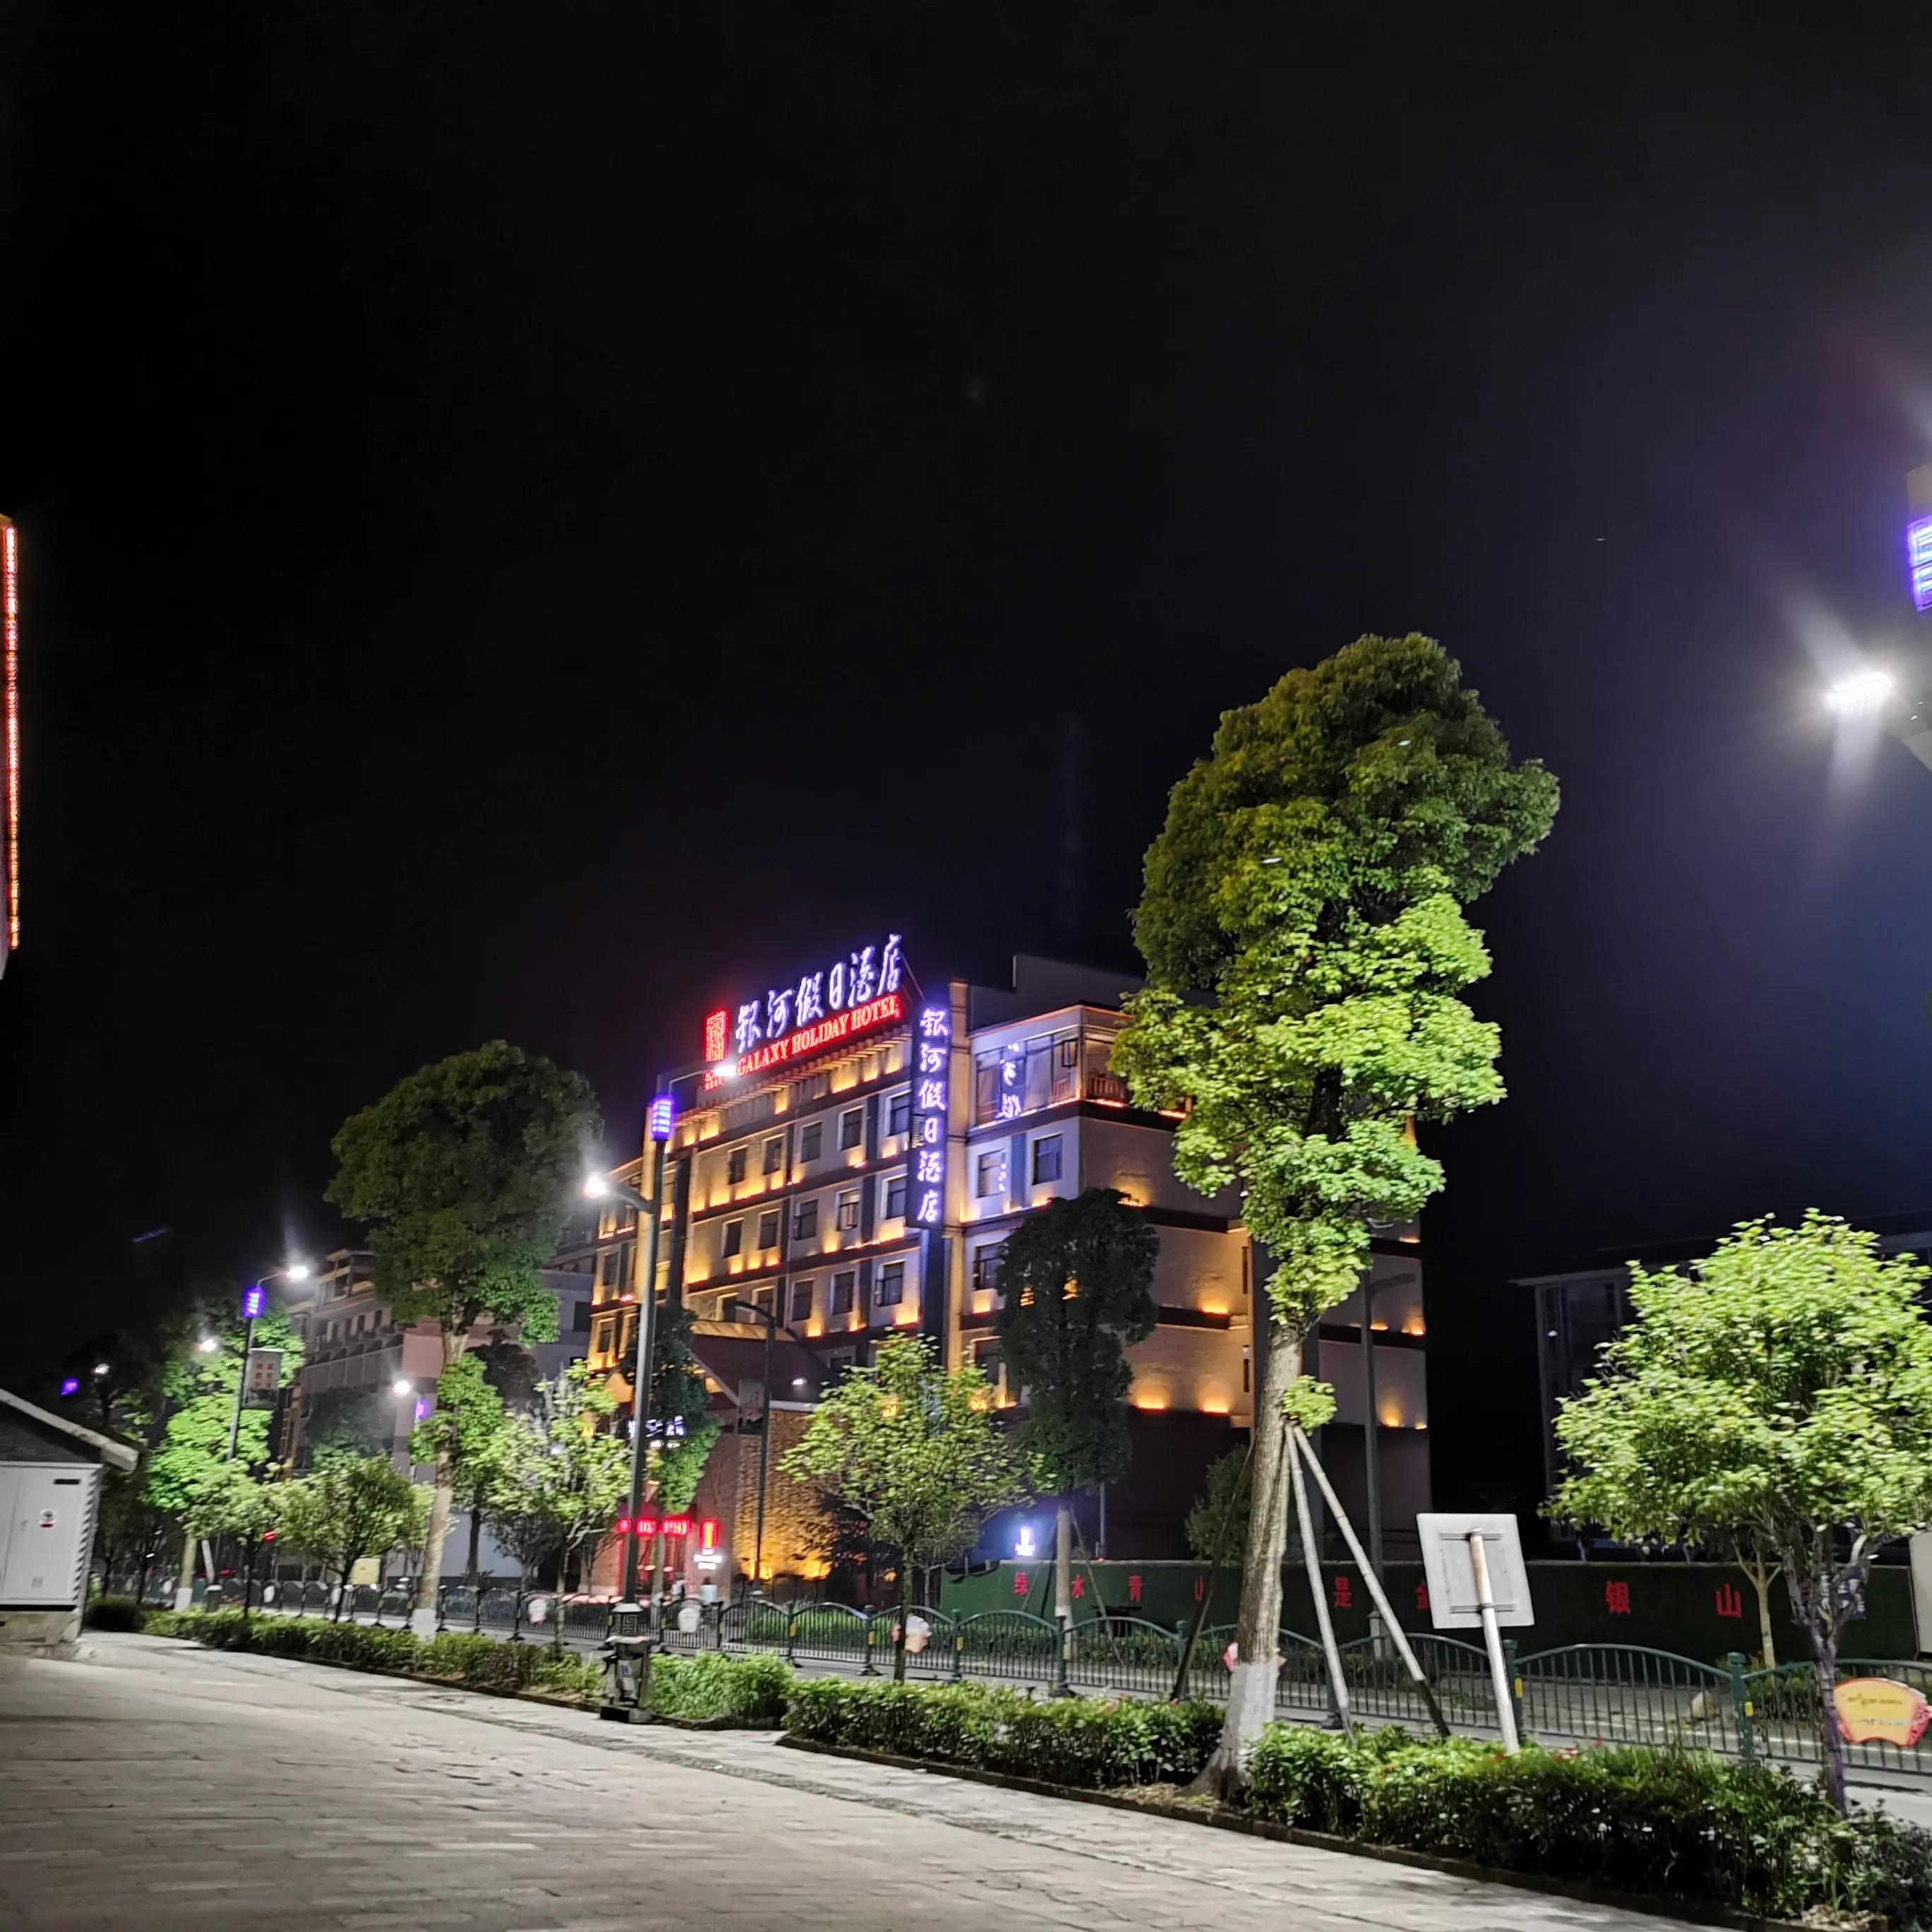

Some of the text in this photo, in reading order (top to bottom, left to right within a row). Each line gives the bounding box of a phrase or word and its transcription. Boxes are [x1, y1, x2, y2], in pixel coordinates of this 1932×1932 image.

[735, 934, 902, 1053] 银河假日酒店
[736, 995, 900, 1076] GALAXY HOLIDAY HOTEL
[917, 1008, 948, 1222] 银河假日酒店
